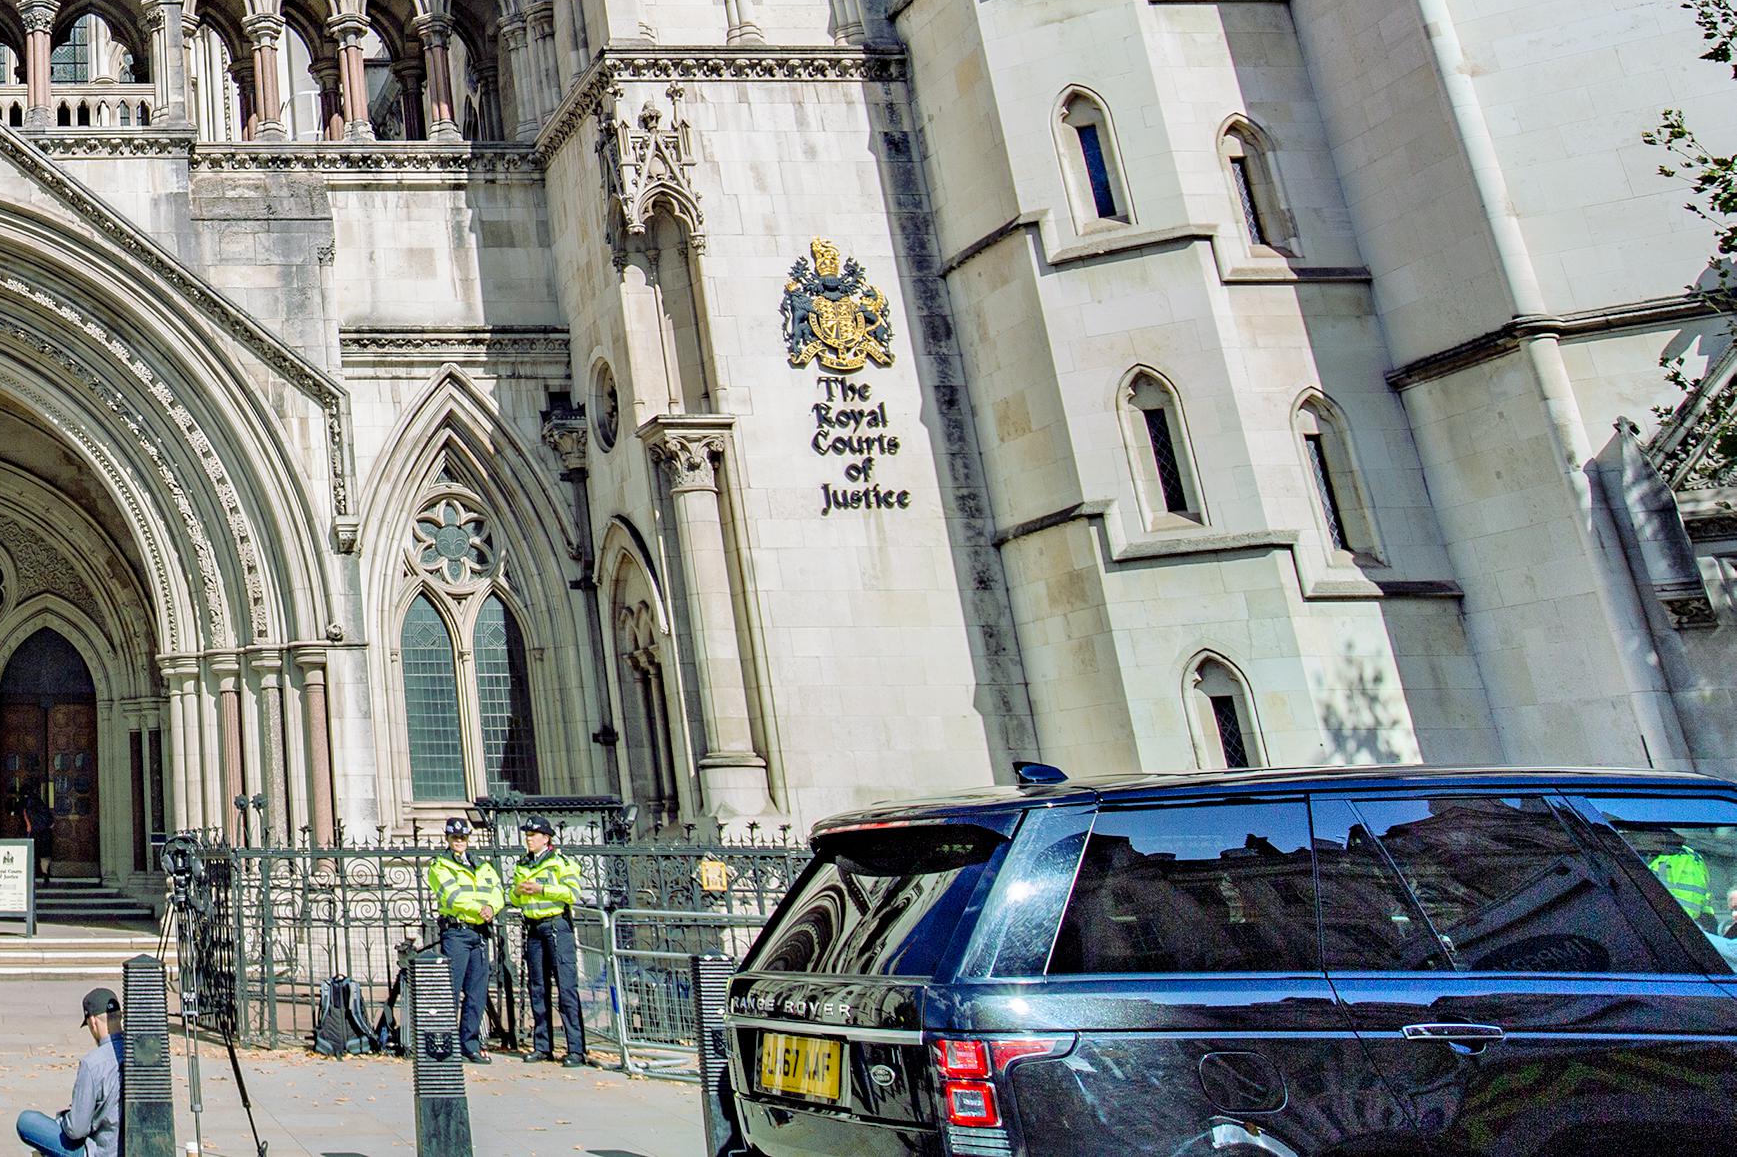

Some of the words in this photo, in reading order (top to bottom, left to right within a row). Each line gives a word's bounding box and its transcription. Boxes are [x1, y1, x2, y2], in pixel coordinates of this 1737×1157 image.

[817, 377, 872, 402] The
[811, 402, 889, 434] Royal
[811, 429, 901, 456] Courts
[845, 456, 875, 482] of
[821, 483, 912, 516] Justice
[731, 996, 775, 1013] RANGE
[784, 1001, 850, 1017] ROVER
